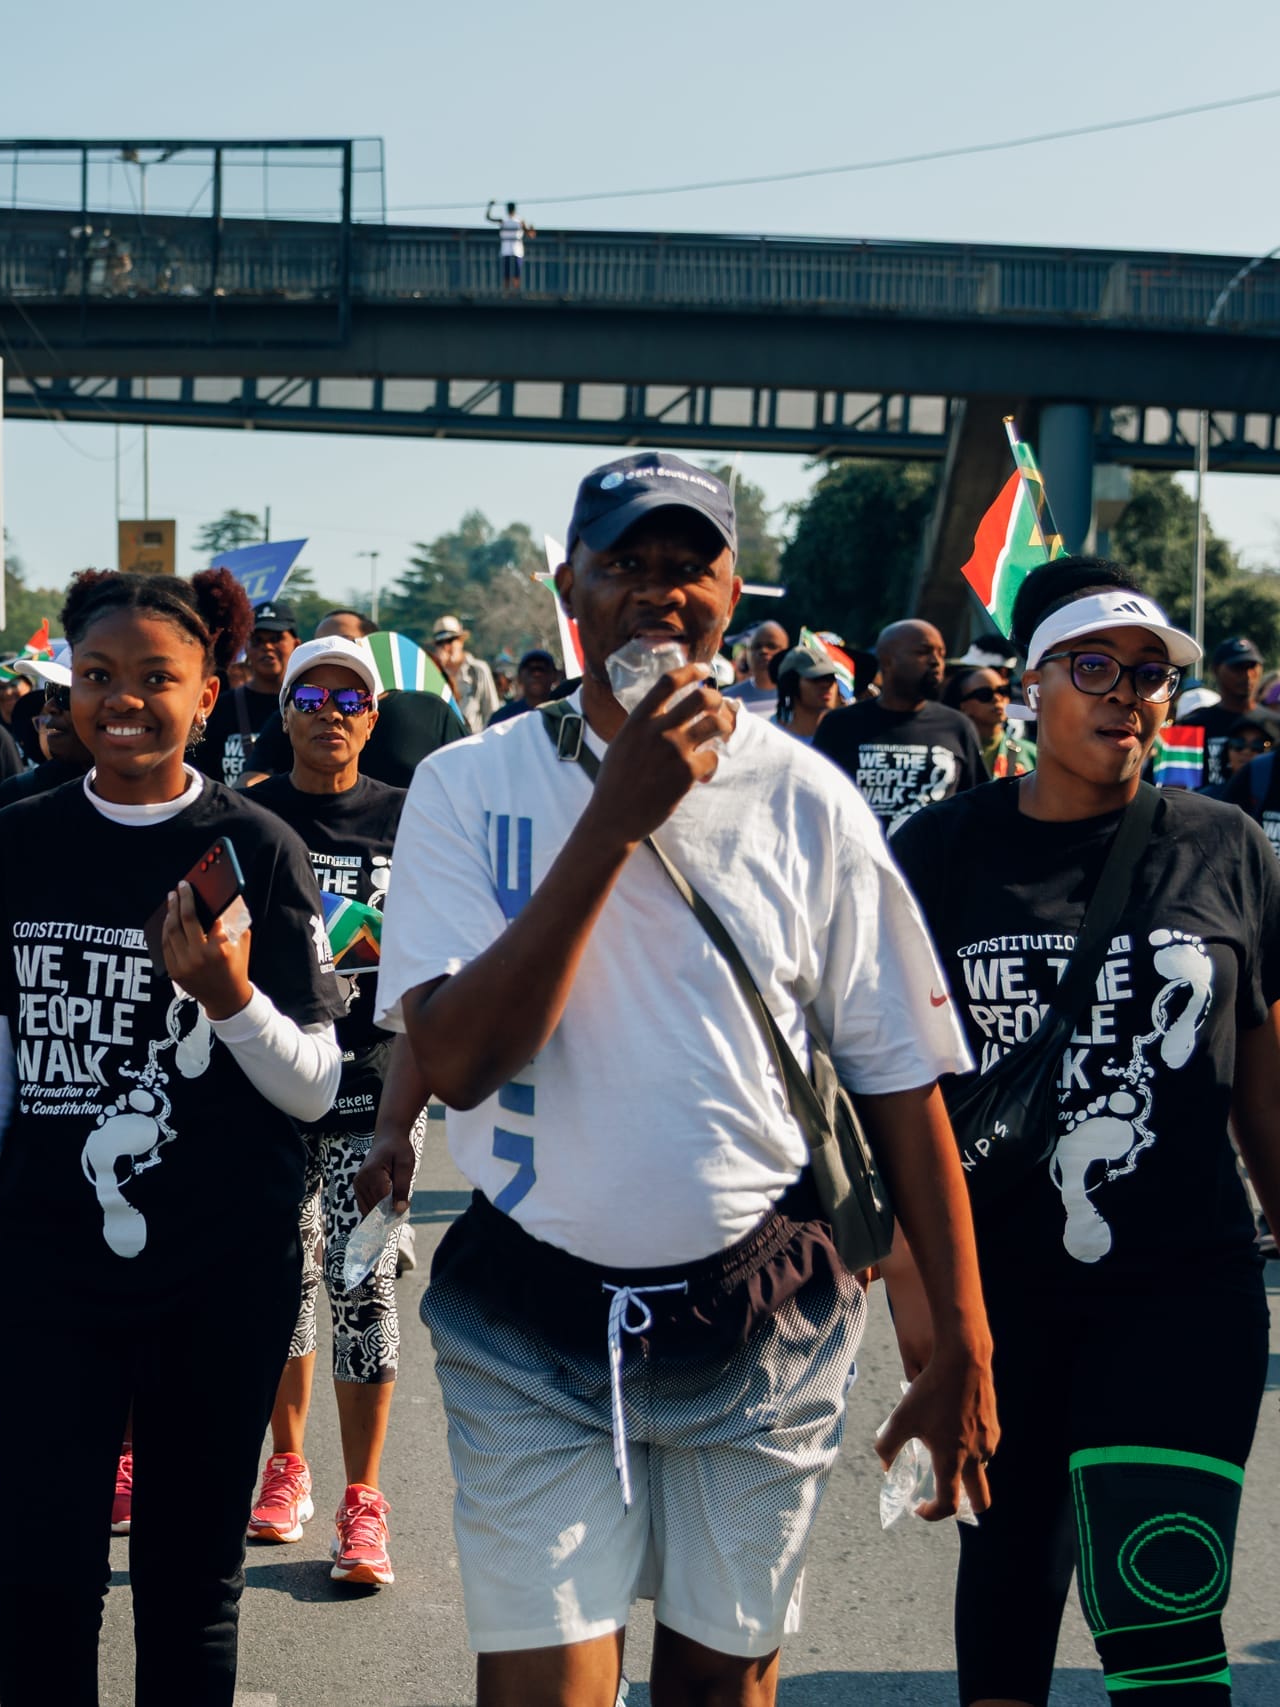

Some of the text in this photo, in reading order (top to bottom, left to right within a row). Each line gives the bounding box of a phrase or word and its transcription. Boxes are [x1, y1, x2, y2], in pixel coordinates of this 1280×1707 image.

[892, 753, 927, 770] THE
[856, 769, 919, 788] PEOPLE
[13, 944, 153, 1002] WE, THE
[963, 957, 1133, 1005] WE, TE
[19, 992, 135, 1046] PEOPLE
[16, 1039, 110, 1087] WALK
[85, 1085, 101, 1097] of
[32, 1101, 103, 1115] Constitution
